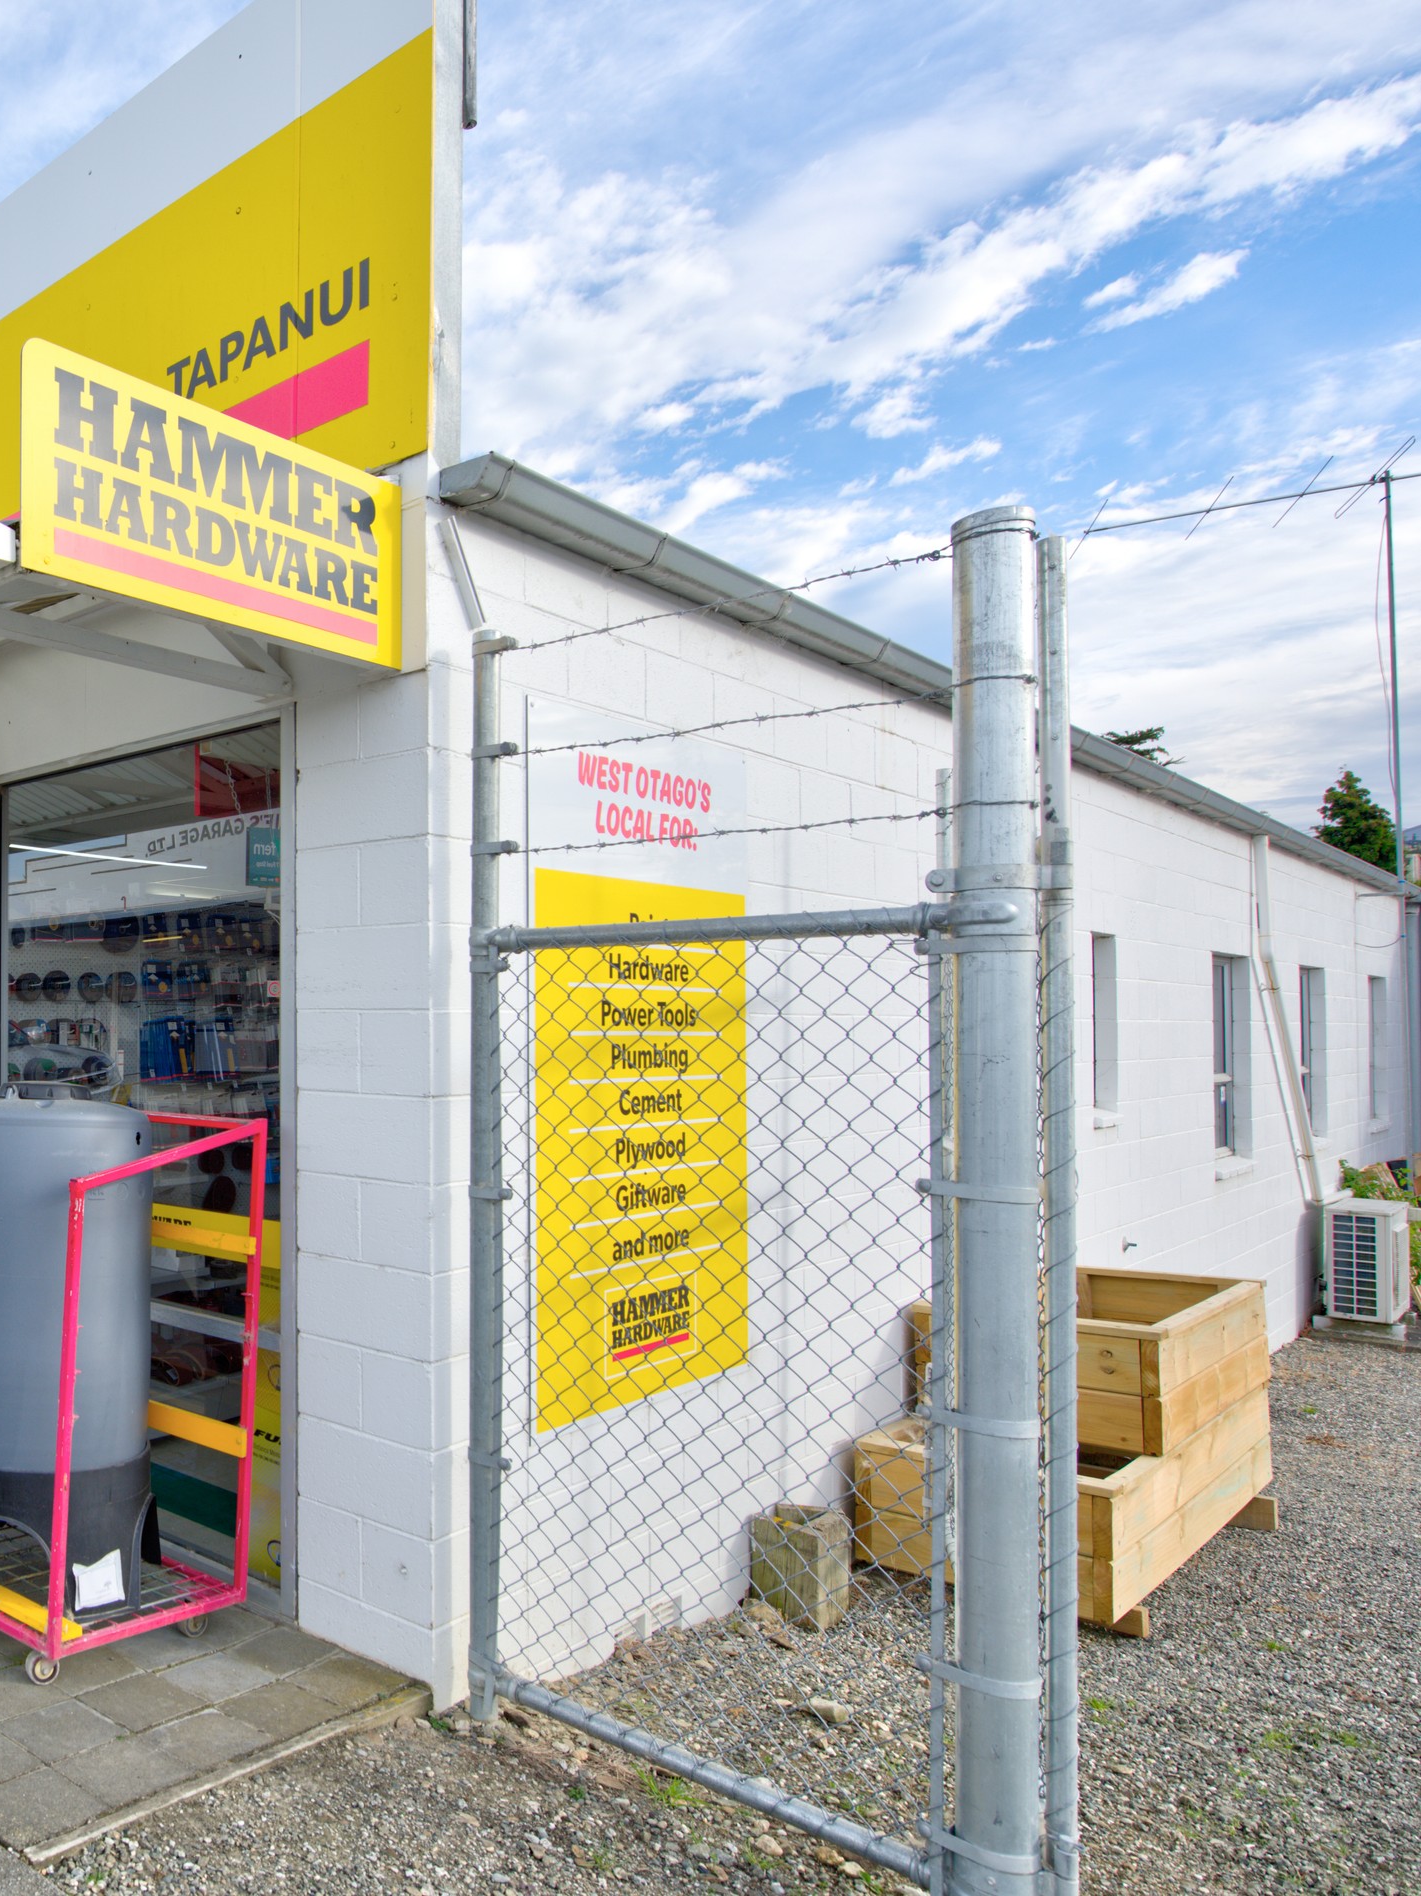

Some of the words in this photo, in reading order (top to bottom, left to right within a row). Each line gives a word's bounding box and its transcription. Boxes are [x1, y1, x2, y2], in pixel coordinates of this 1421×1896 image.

[166, 257, 370, 399] TAPANUI
[54, 367, 378, 557] HAMMER
[54, 456, 378, 615] HARDWARE
[578, 751, 633, 795] WEST
[636, 766, 711, 813] OTAGO'S
[595, 800, 655, 843] LOCAL
[609, 953, 689, 982] Hardware
[601, 1000, 654, 1027] Power
[657, 1001, 696, 1027] Tools
[611, 1043, 689, 1073] Plumbing
[619, 1089, 682, 1115] Cement
[616, 1132, 686, 1169] Plywood
[616, 1182, 686, 1212] Giftware
[613, 1229, 644, 1262] and
[649, 1228, 689, 1254] more
[612, 1284, 689, 1327] HAMMER
[612, 1311, 689, 1349] HARDWARE
